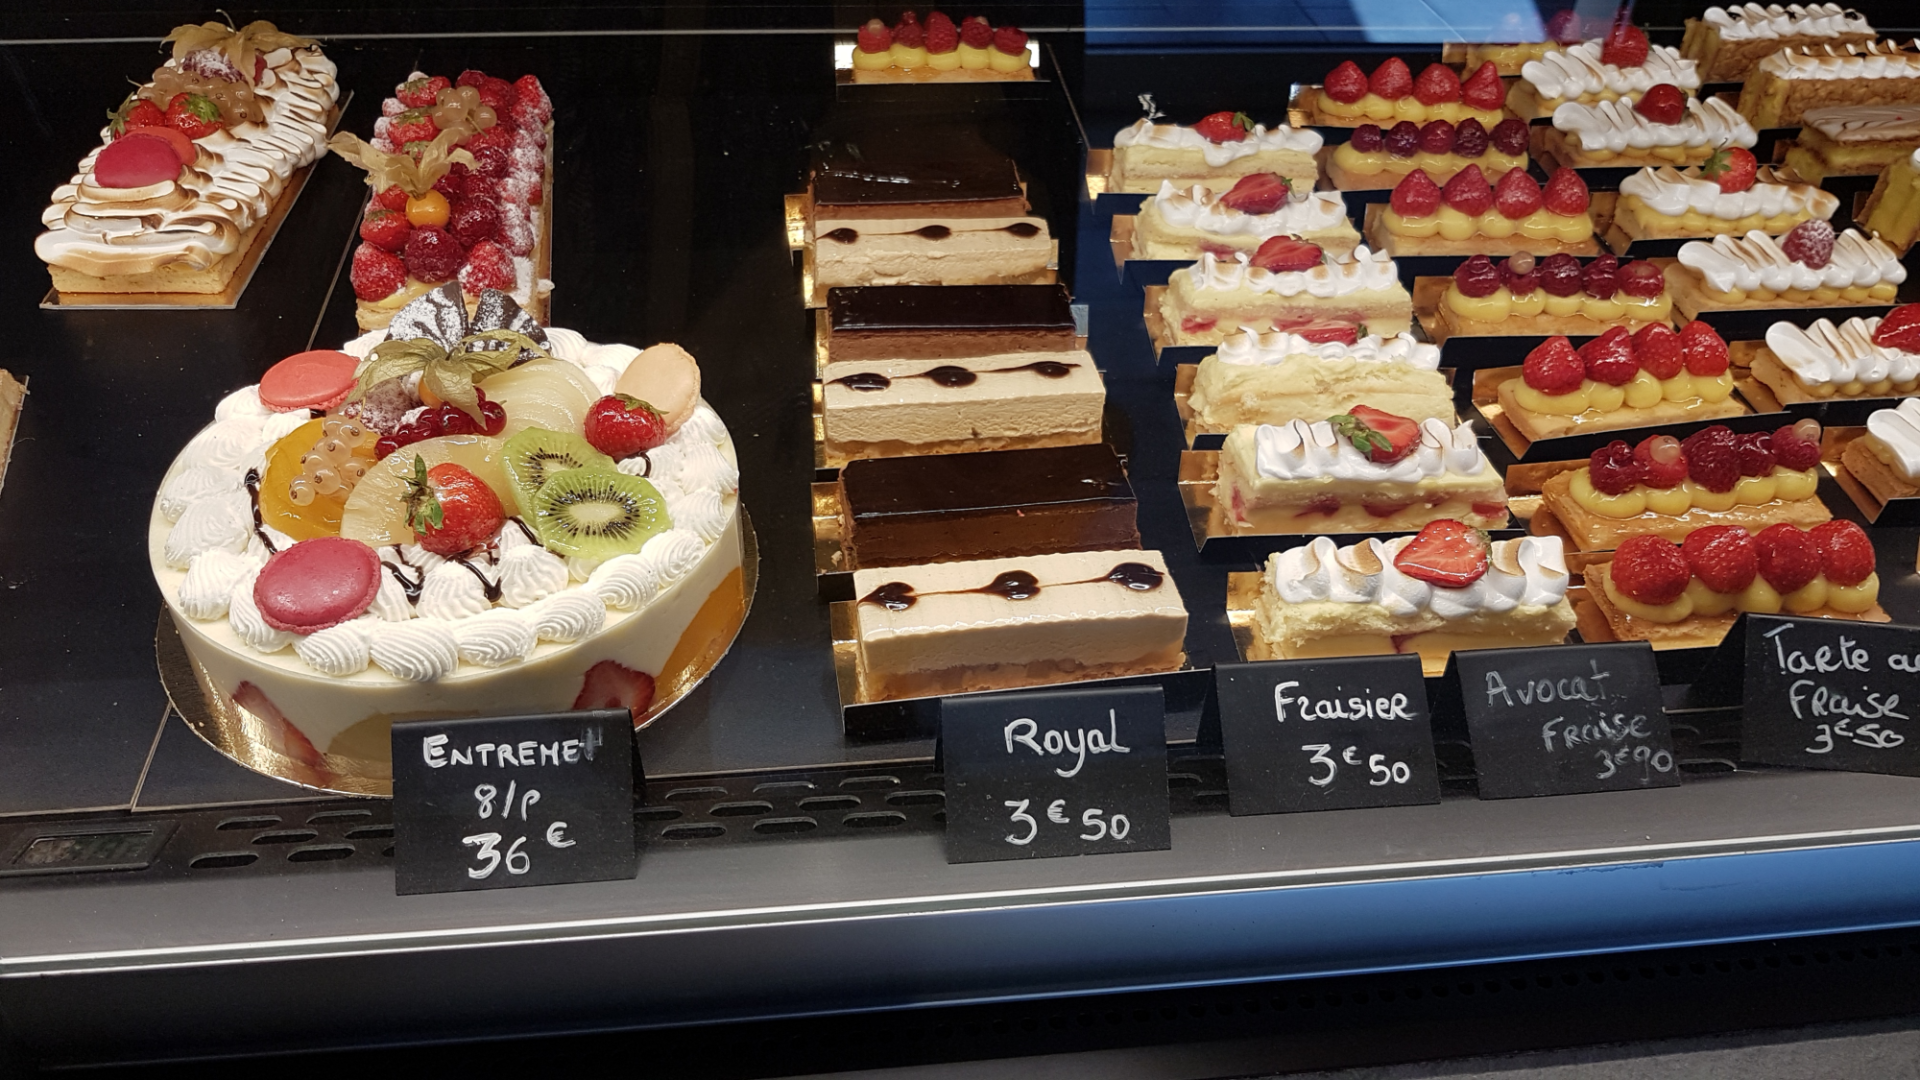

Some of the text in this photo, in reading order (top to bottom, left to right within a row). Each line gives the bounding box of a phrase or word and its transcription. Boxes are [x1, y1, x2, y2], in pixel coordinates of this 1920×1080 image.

[1763, 622, 1870, 675] Tarte
[1274, 680, 1418, 723] Fraisier
[1485, 659, 1610, 707] Avocat
[1789, 679, 1910, 720] Fraise
[1004, 708, 1130, 778] Royal
[1541, 711, 1652, 752] Fraise
